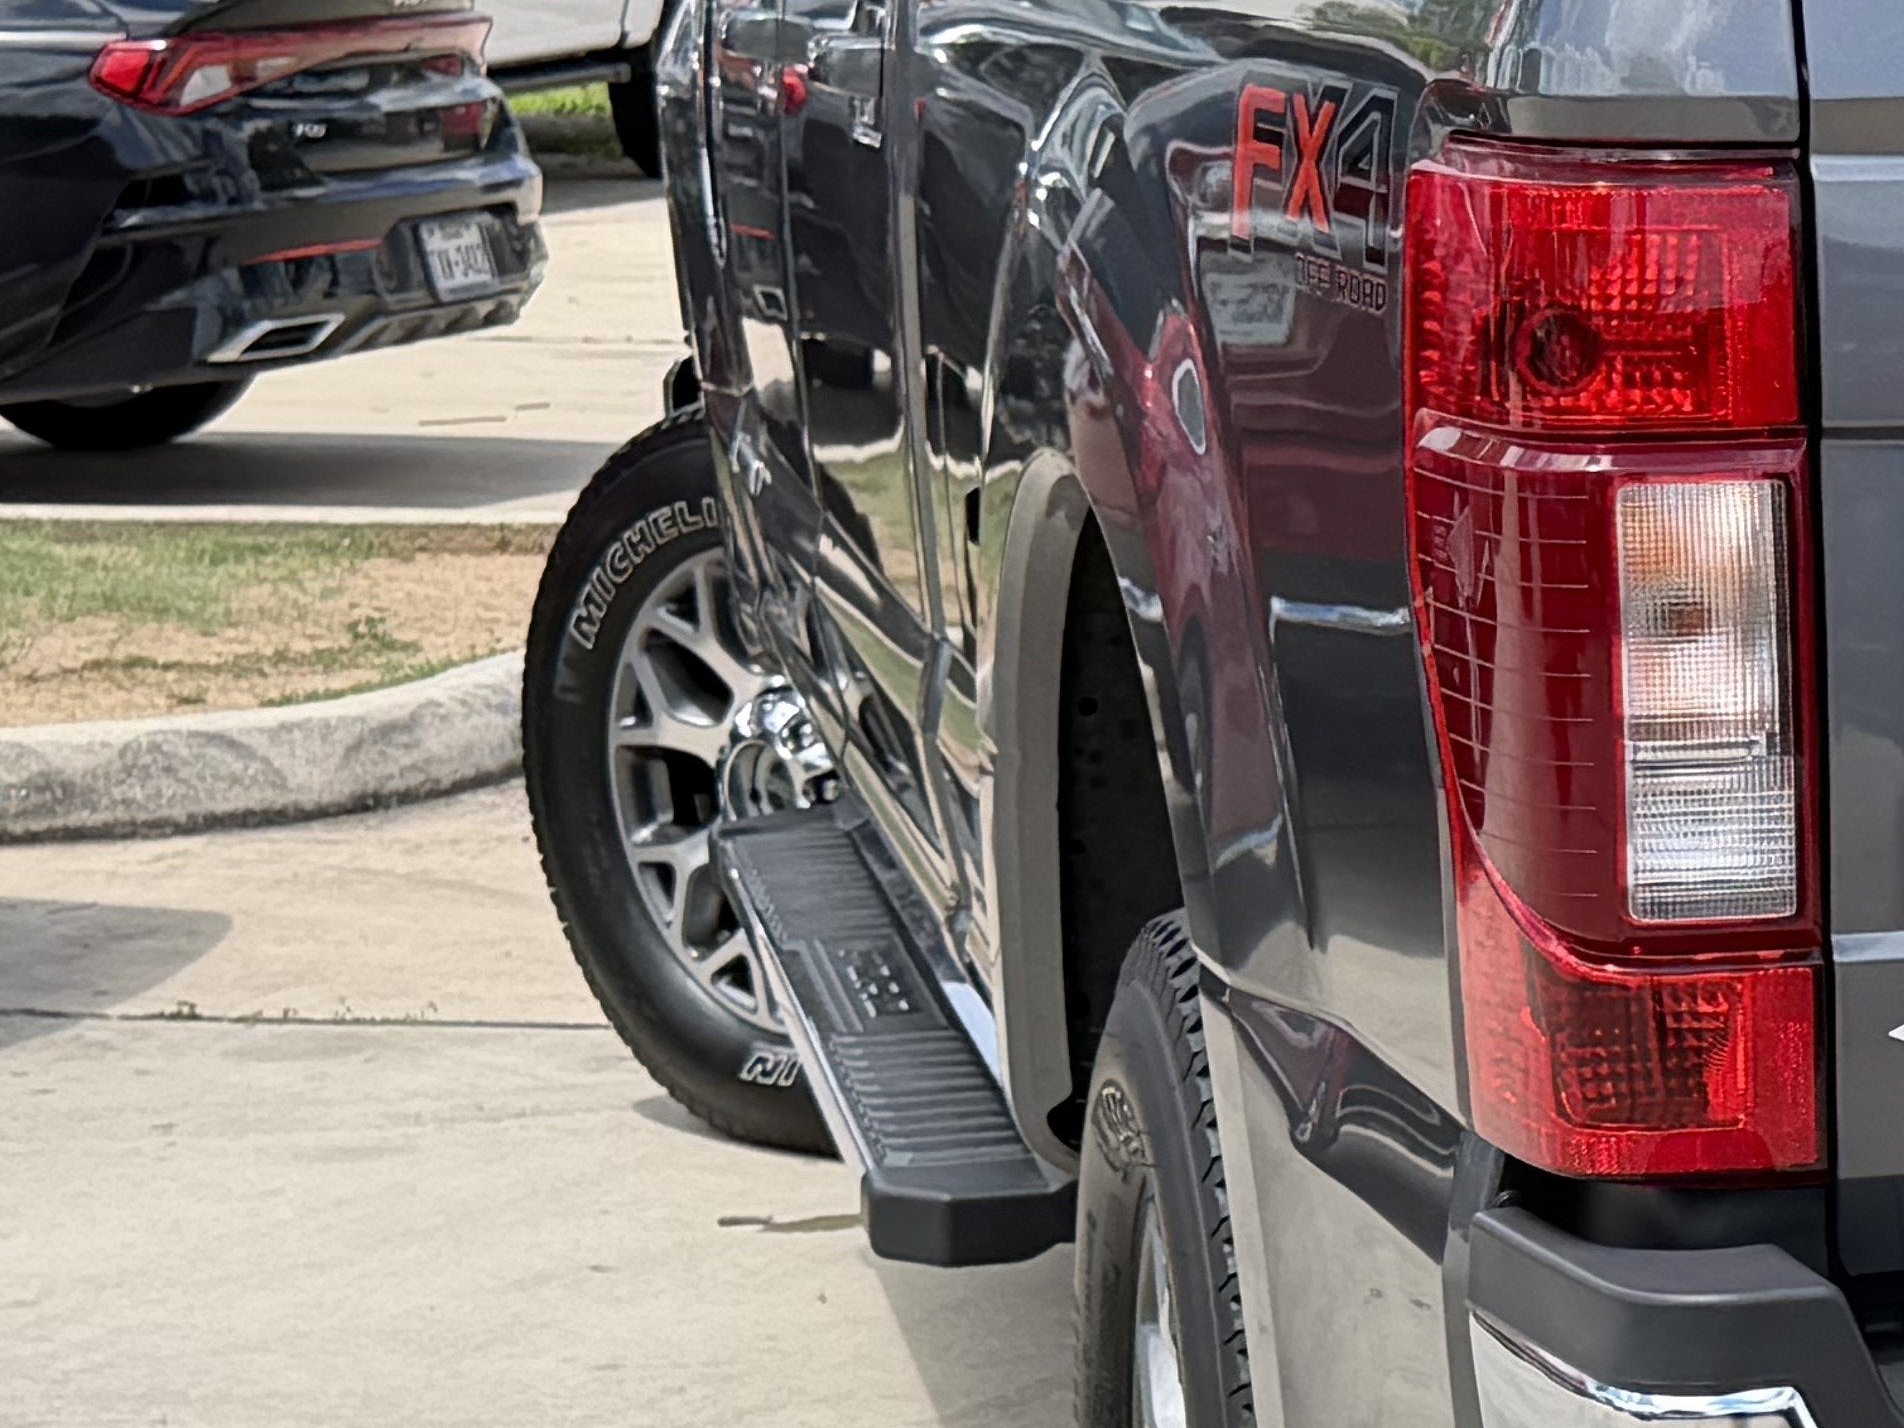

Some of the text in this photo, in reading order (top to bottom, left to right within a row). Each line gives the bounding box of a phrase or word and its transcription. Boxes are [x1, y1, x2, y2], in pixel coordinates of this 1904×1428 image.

[1228, 75, 1399, 271] FX4
[1334, 263, 1388, 314] ROAD
[569, 496, 724, 650] MICHELI
